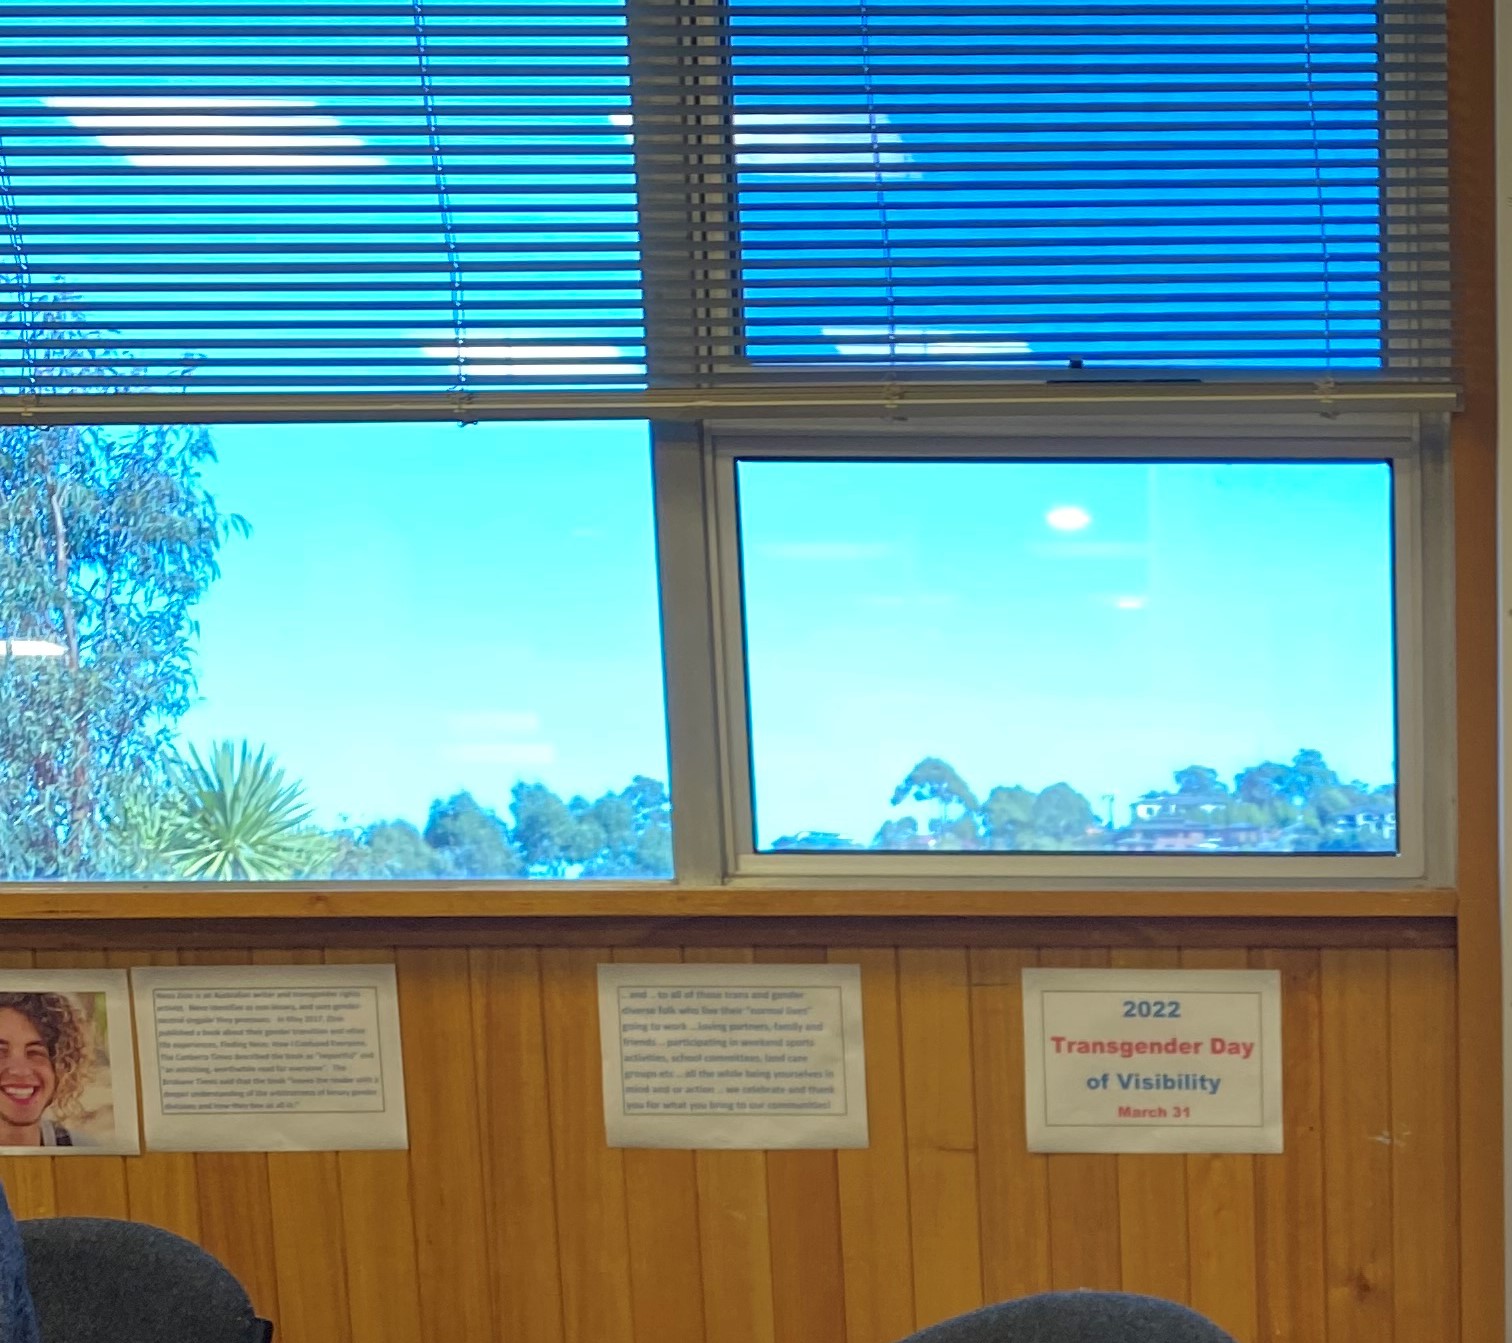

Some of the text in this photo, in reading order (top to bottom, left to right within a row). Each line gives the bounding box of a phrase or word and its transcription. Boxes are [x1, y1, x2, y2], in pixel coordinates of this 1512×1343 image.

[1123, 1001, 1181, 1018] 2022
[1051, 1037, 1254, 1058] Transgender Day
[1086, 1073, 1221, 1095] of Visibility
[1118, 1106, 1190, 1118] March 31
